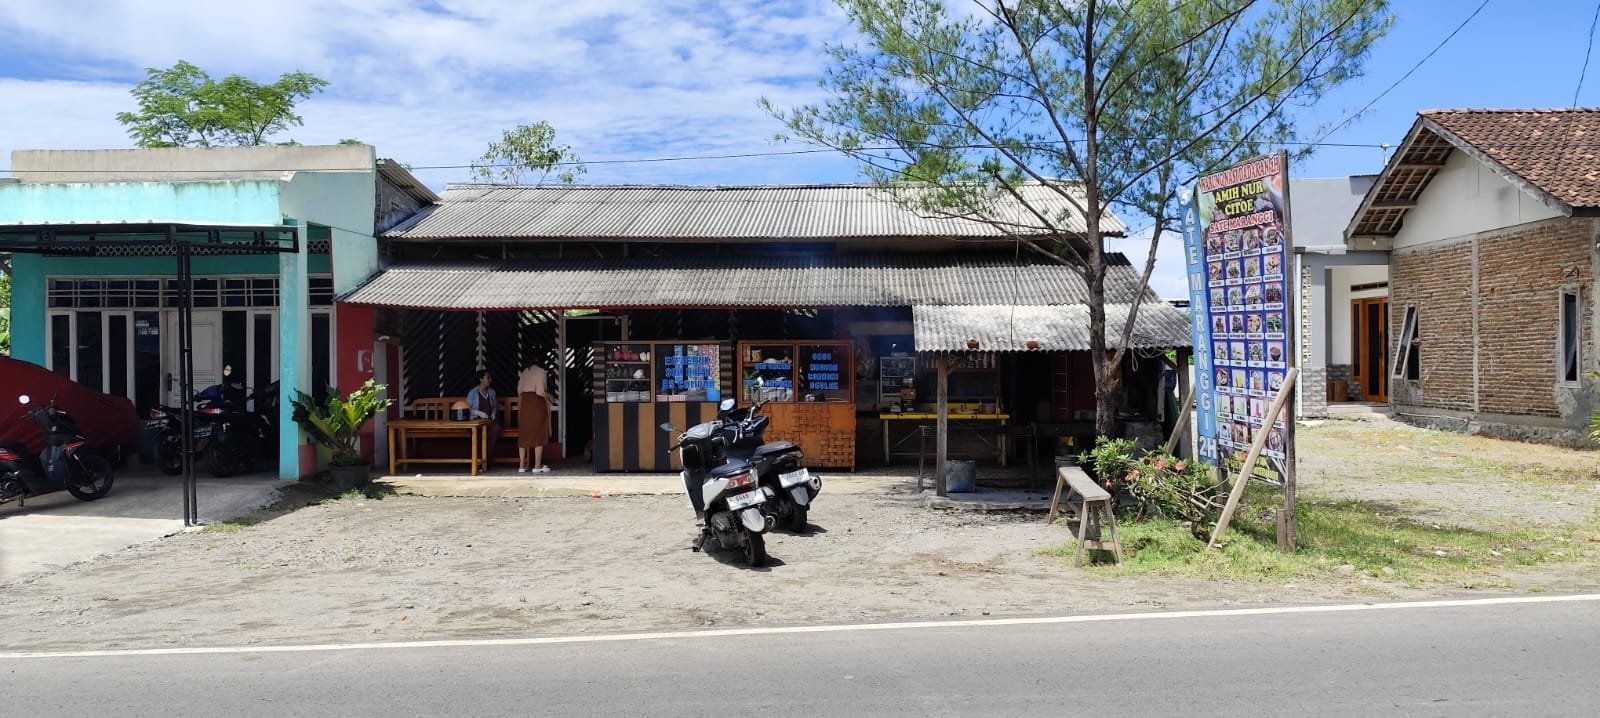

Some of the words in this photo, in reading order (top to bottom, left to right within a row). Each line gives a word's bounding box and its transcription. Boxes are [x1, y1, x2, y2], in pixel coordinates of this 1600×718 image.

[1215, 186, 1240, 203] AMIH
[1240, 180, 1264, 198] NUR
[1225, 199, 1254, 215] CITOE
[1210, 219, 1229, 233] SATE
[1228, 210, 1274, 229] MARANGGI
[1191, 273, 1211, 430] MARANGGI
[1200, 436, 1217, 460] 2H
